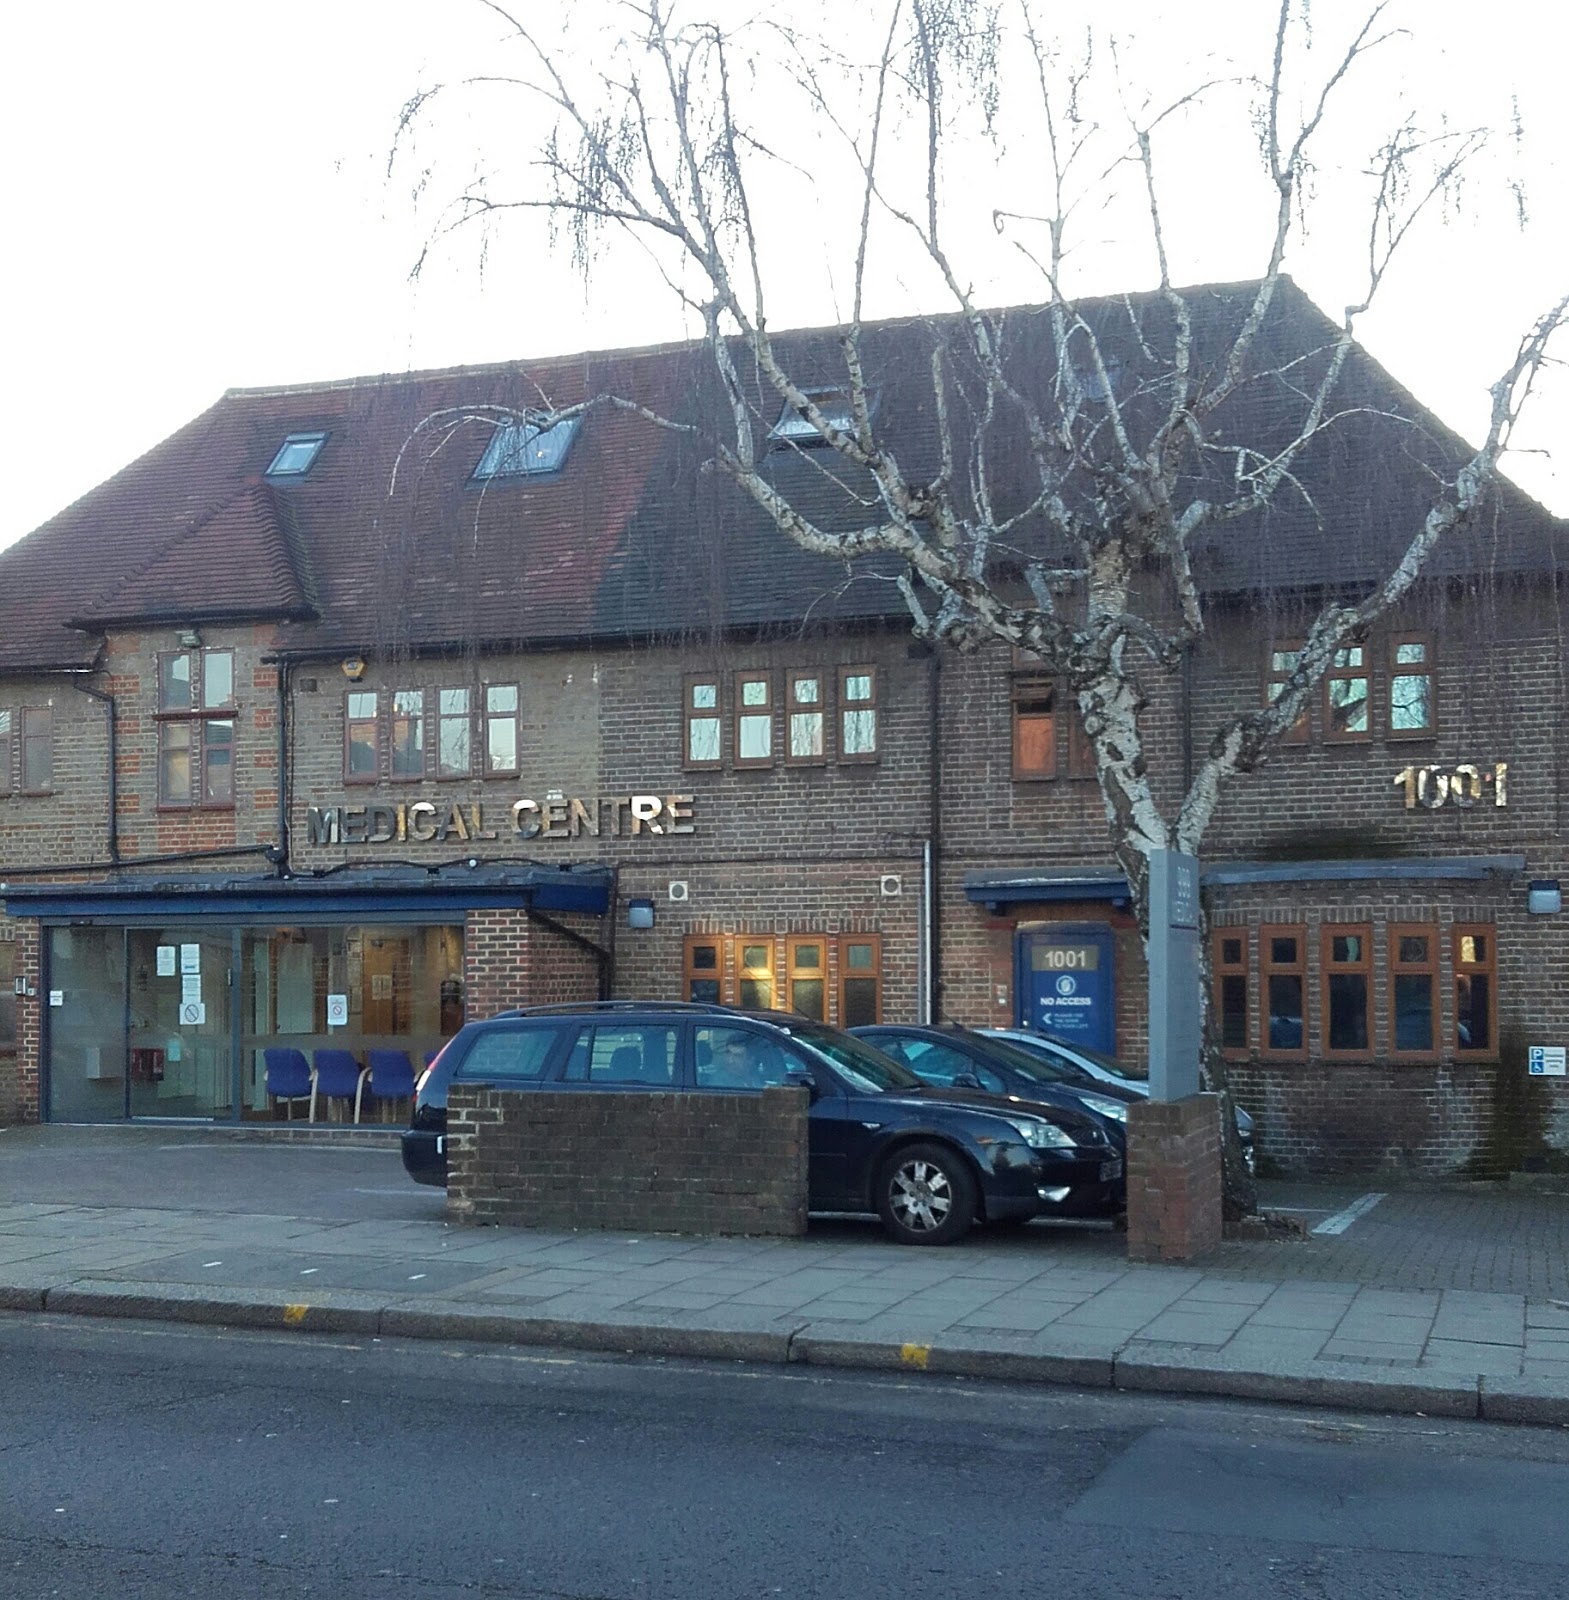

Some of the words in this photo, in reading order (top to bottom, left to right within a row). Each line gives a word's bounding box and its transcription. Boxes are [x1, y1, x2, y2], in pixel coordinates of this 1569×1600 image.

[1393, 762, 1508, 809] 1001
[306, 801, 498, 844] MEDICAL
[512, 794, 696, 839] CENTRE
[1045, 951, 1086, 967] 1001
[1040, 997, 1055, 1006] NO
[1055, 997, 1092, 1006] ACCESS
[1533, 1049, 1543, 1060] P
